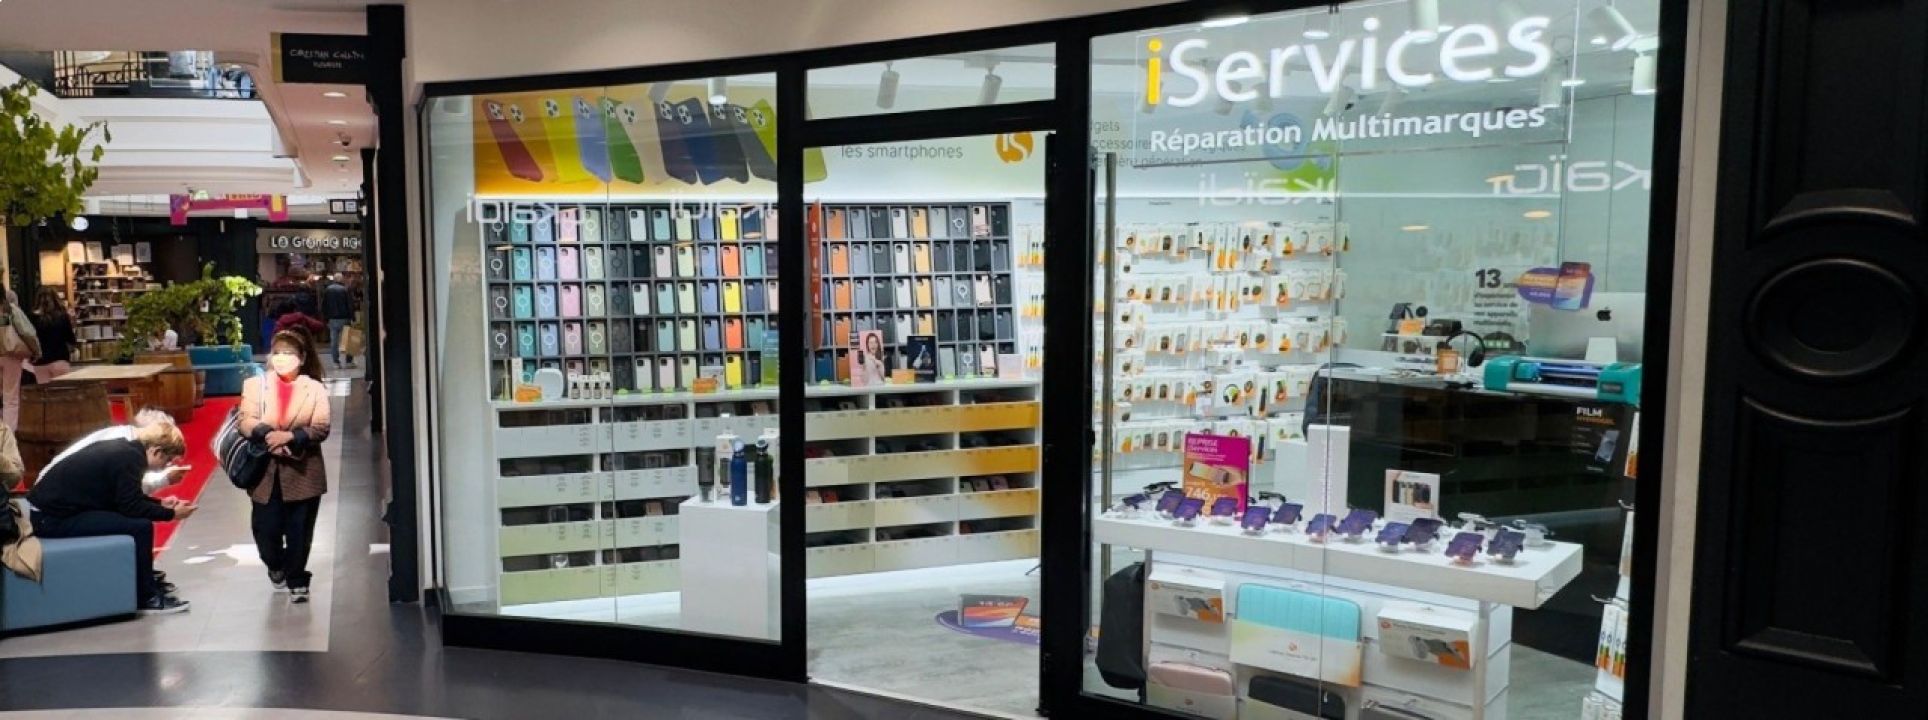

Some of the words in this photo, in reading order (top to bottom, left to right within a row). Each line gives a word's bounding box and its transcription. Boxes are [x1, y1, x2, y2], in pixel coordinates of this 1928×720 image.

[1147, 16, 1551, 107] iServices
[1093, 120, 1120, 133] gets
[1151, 121, 1301, 155] Réparation
[1312, 106, 1546, 141] Multimarques
[841, 145, 862, 159] les
[868, 144, 963, 160] smartphones
[1475, 268, 1502, 289] 13
